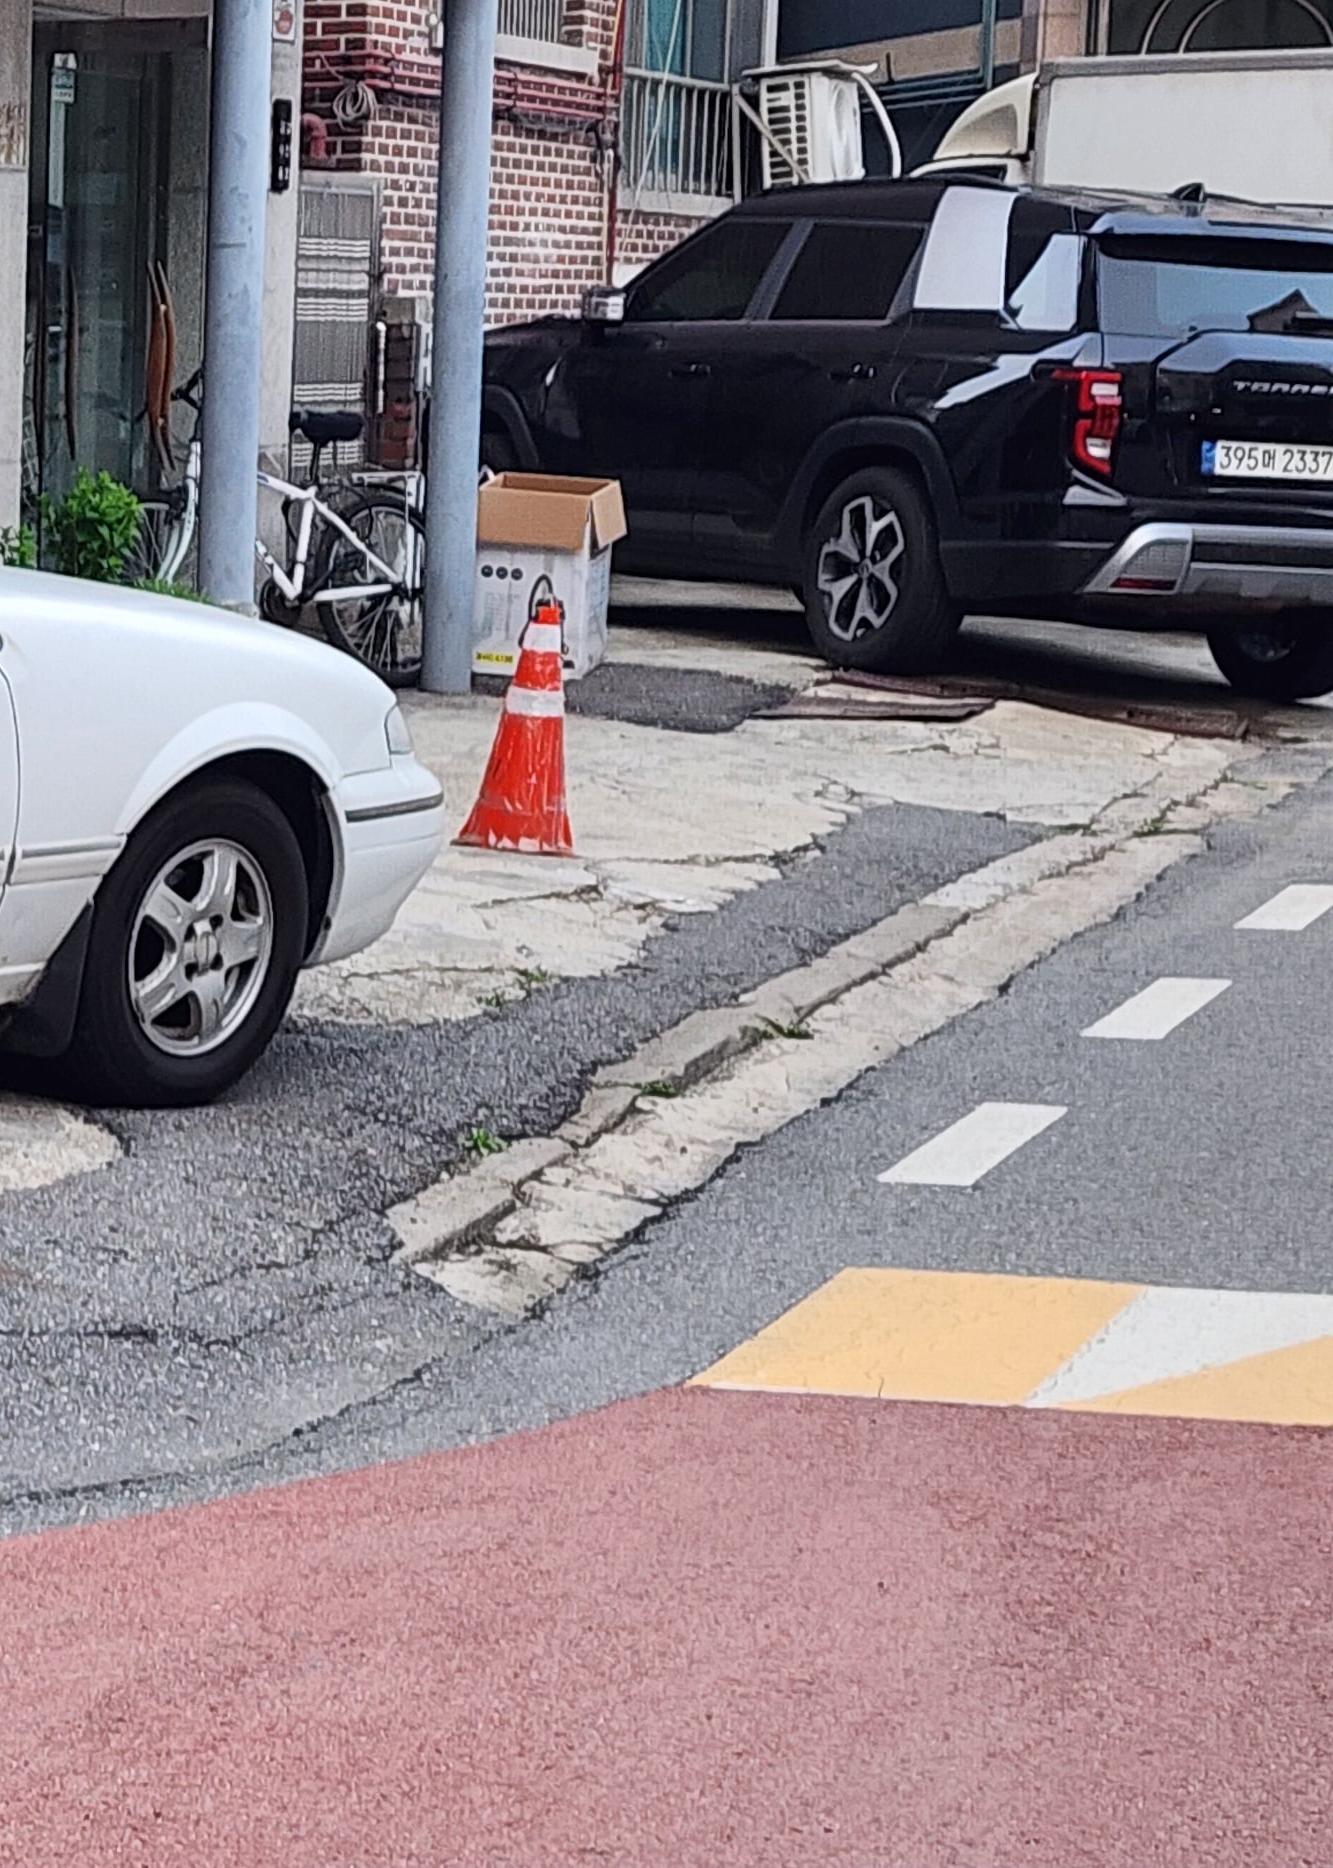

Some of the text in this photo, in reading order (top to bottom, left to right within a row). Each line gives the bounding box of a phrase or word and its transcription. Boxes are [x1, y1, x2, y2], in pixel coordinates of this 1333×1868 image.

[1233, 381, 1333, 394] TORRE
[1219, 445, 1333, 475] 395머 2337
